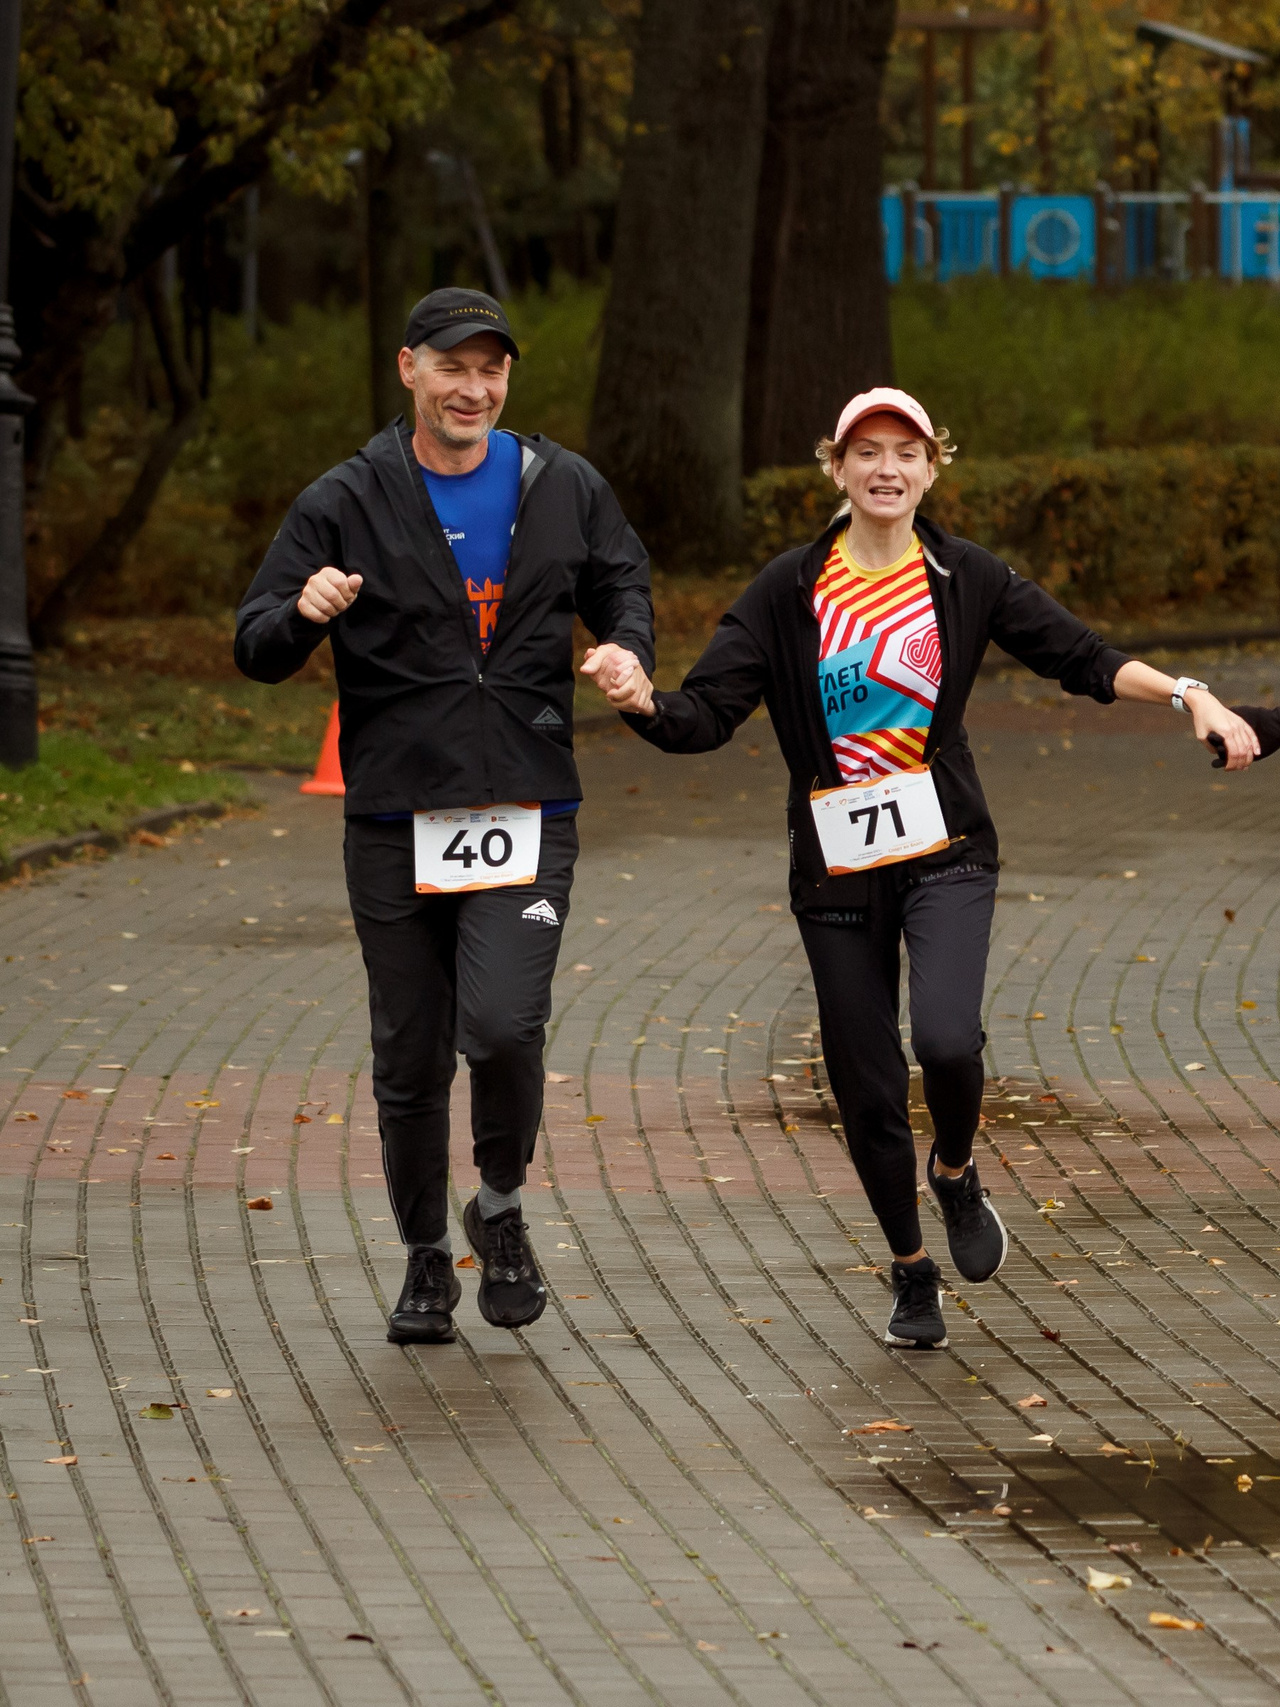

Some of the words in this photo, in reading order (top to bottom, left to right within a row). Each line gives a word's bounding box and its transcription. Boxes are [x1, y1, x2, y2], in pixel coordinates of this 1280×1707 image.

[818, 660, 864, 694] ЛЕТ
[826, 684, 869, 717] АГО
[848, 799, 906, 847] 71
[442, 828, 513, 869] 40
